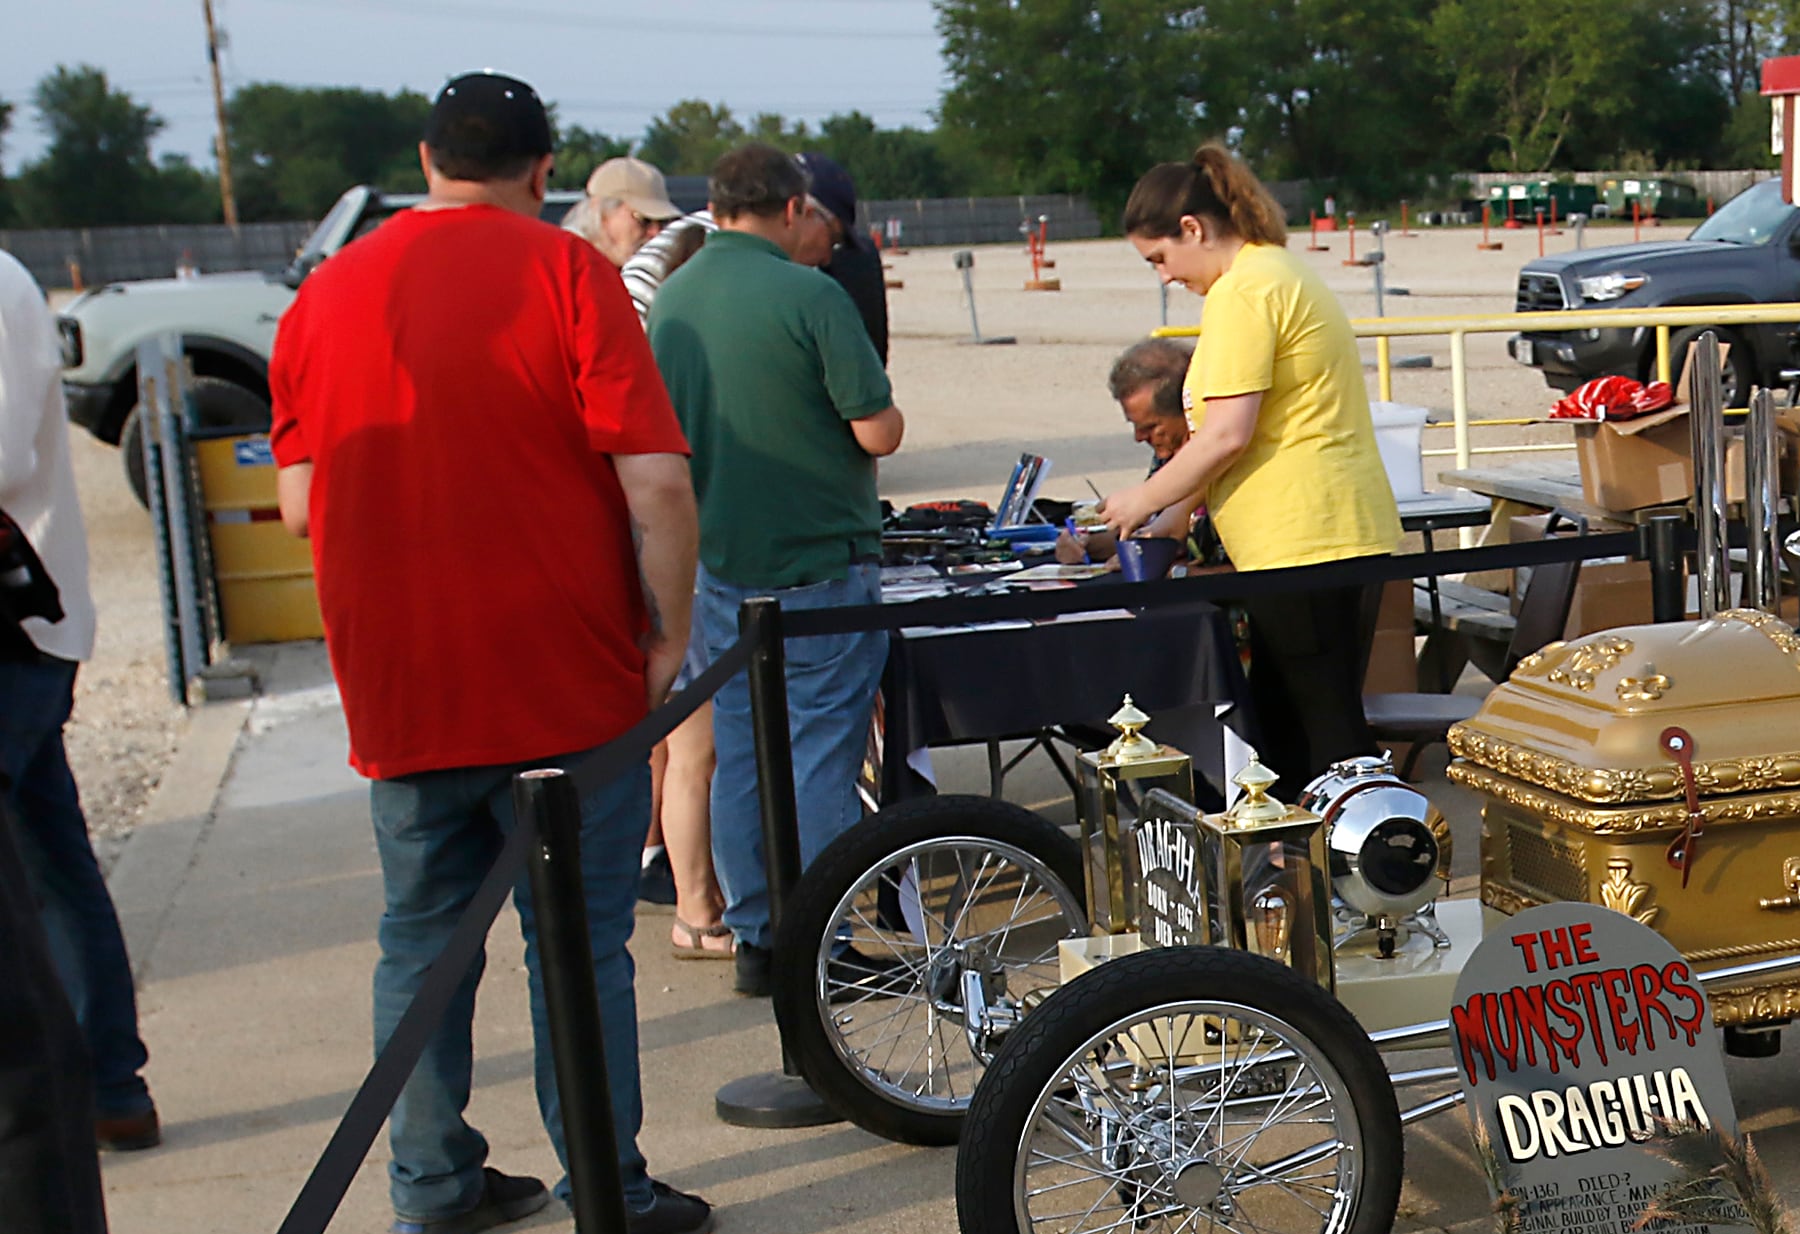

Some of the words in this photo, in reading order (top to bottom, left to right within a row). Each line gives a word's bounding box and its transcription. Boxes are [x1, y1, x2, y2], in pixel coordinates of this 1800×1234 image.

[1512, 922, 1600, 973] THE
[1451, 961, 1705, 1085] MUNSTERS
[1540, 1189, 1620, 1213] APPEARANCE
[1629, 1184, 1657, 1201] MAY
[1561, 1209, 1595, 1227] BUILD
[1596, 1206, 1611, 1221] BY
